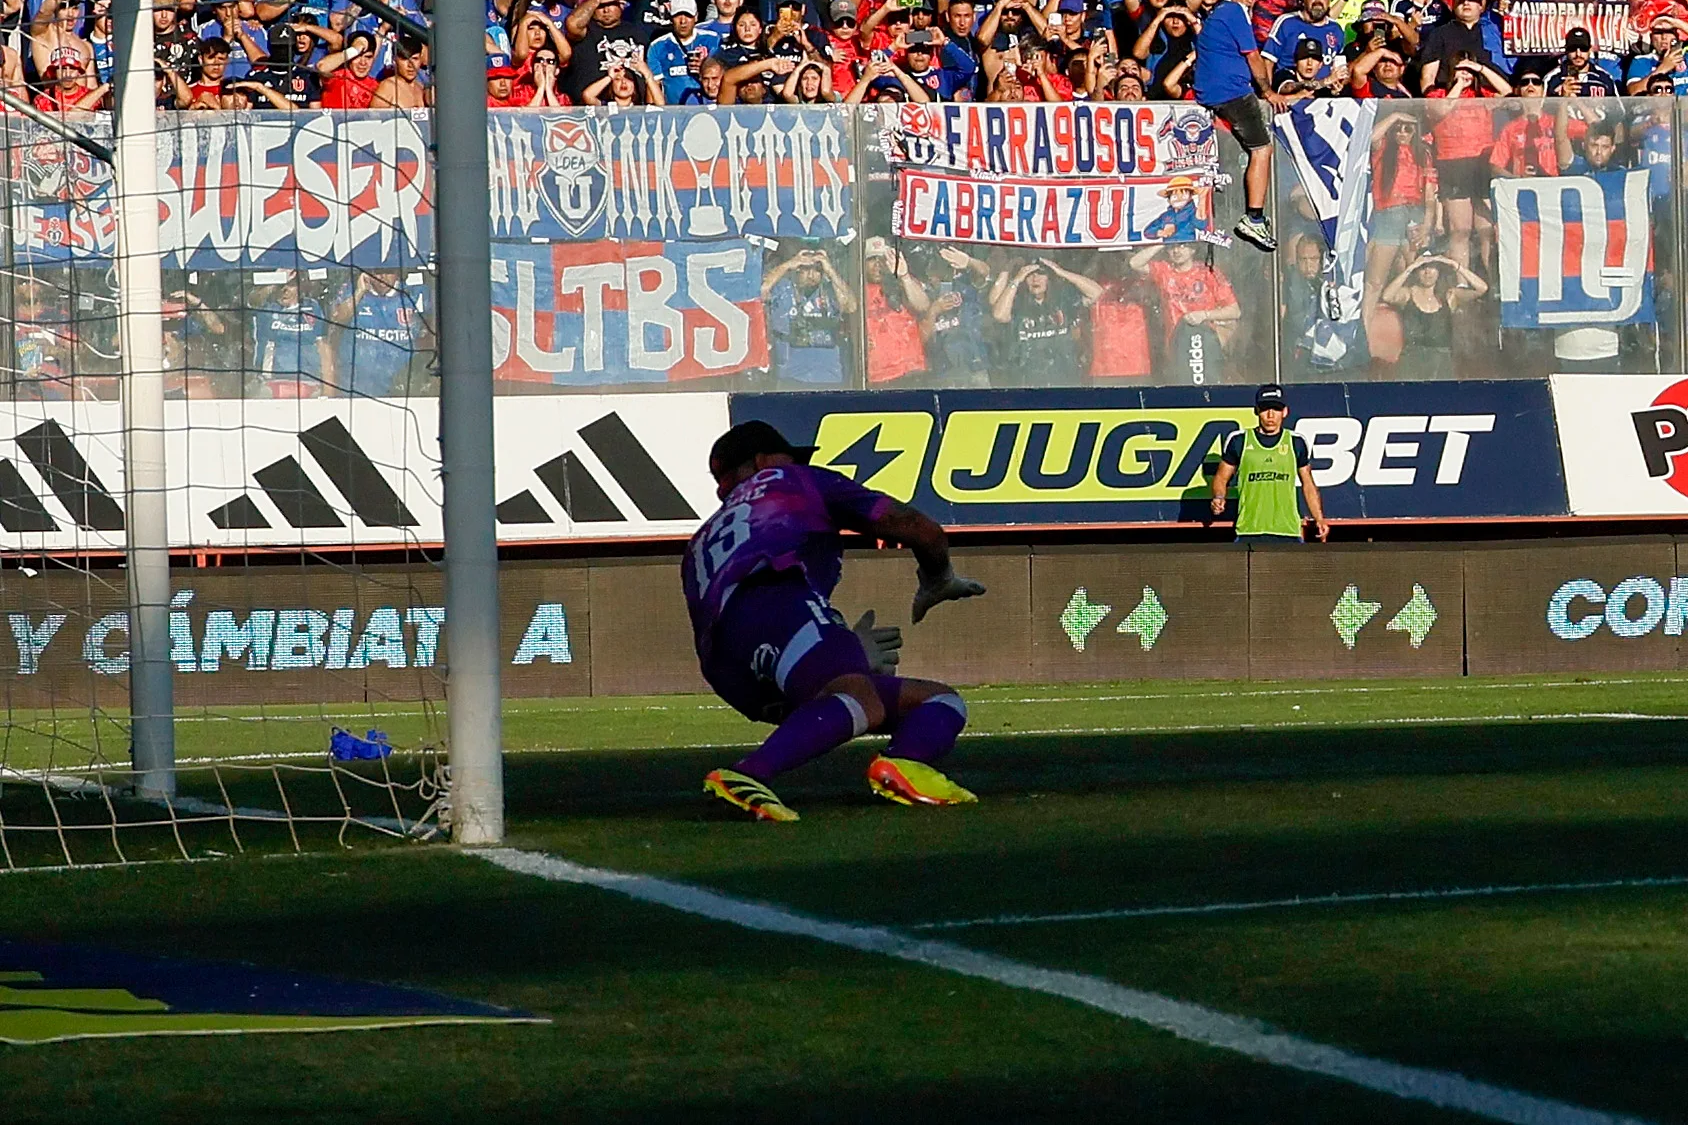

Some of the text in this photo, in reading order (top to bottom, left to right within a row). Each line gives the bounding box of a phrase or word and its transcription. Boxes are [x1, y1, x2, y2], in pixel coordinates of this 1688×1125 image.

[554, 155, 586, 171] LDEA
[907, 178, 1142, 244] CABRERAZUL
[1189, 333, 1205, 385] adidas
[949, 413, 1498, 490] JUGABET
[8, 588, 573, 676] Y CÁMBIAT A
